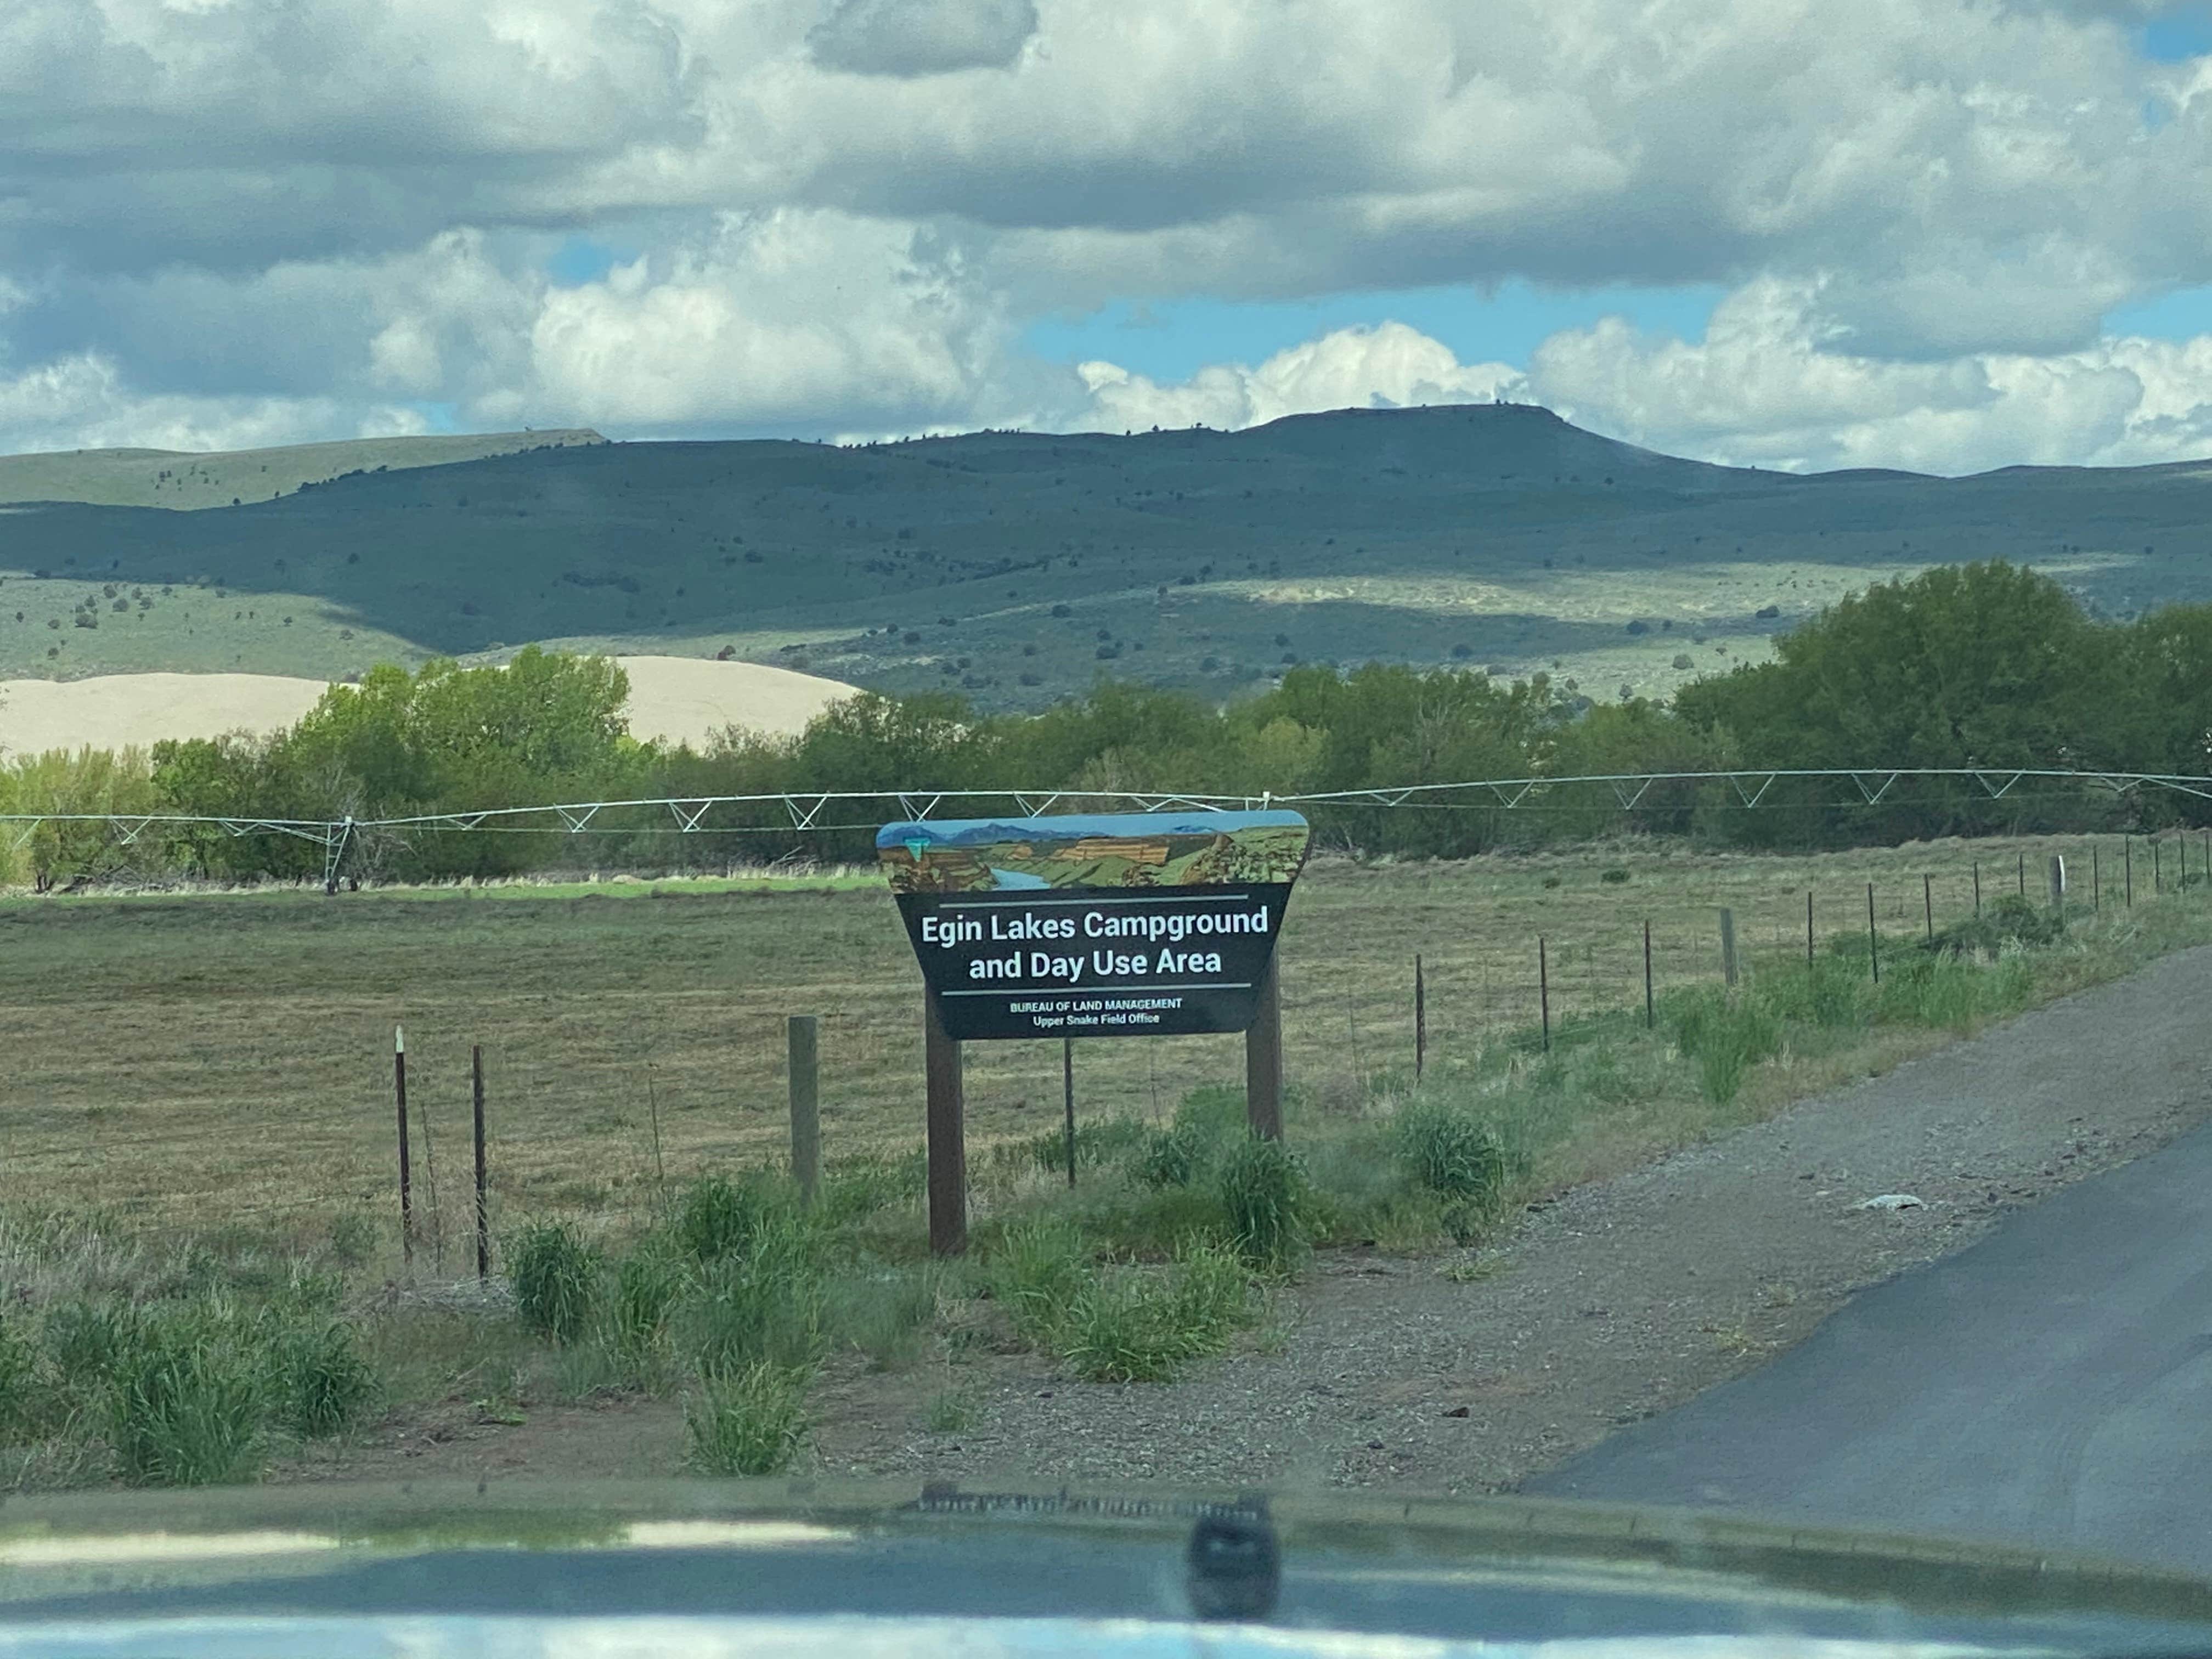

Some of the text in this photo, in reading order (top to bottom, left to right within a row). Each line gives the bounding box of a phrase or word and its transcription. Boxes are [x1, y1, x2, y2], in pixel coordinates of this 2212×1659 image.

[922, 905, 1268, 948] Egin Lakes Campground
[969, 947, 1222, 983] and Day Use Area
[1010, 997, 1183, 1013] BUREAU OF LAND MANAGEMENT
[1033, 1012, 1160, 1028] Upper Snake Field Office
